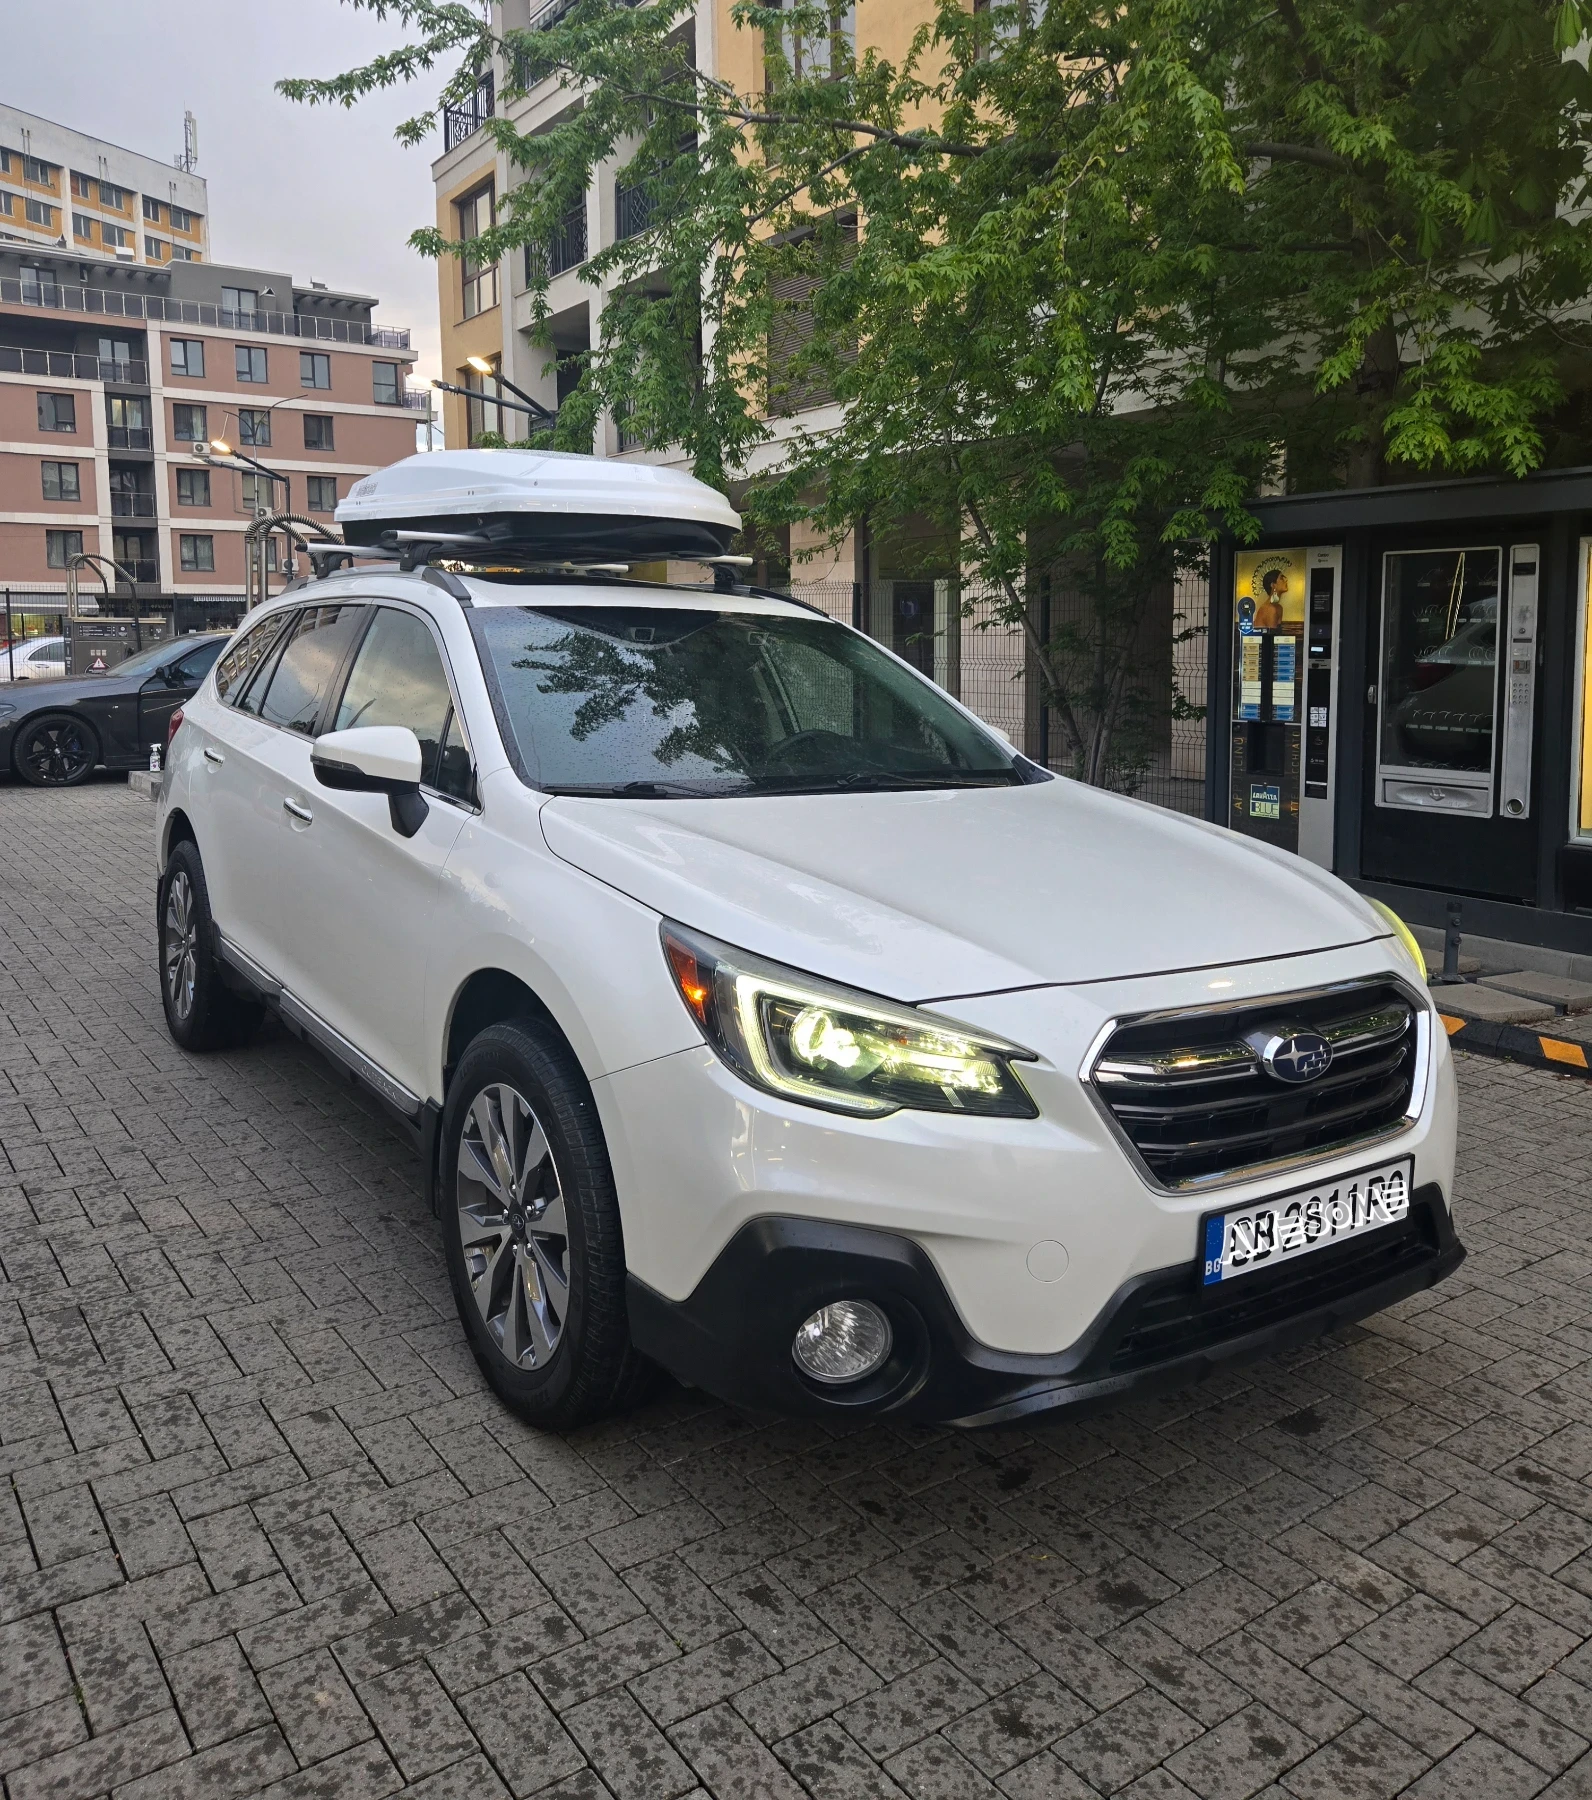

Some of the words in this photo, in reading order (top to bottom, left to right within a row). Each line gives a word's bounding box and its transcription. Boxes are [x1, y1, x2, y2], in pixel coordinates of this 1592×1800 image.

[1252, 791, 1278, 801] LAVAZZA
[1251, 802, 1279, 815] BLUE
[1205, 1257, 1221, 1276] BG
